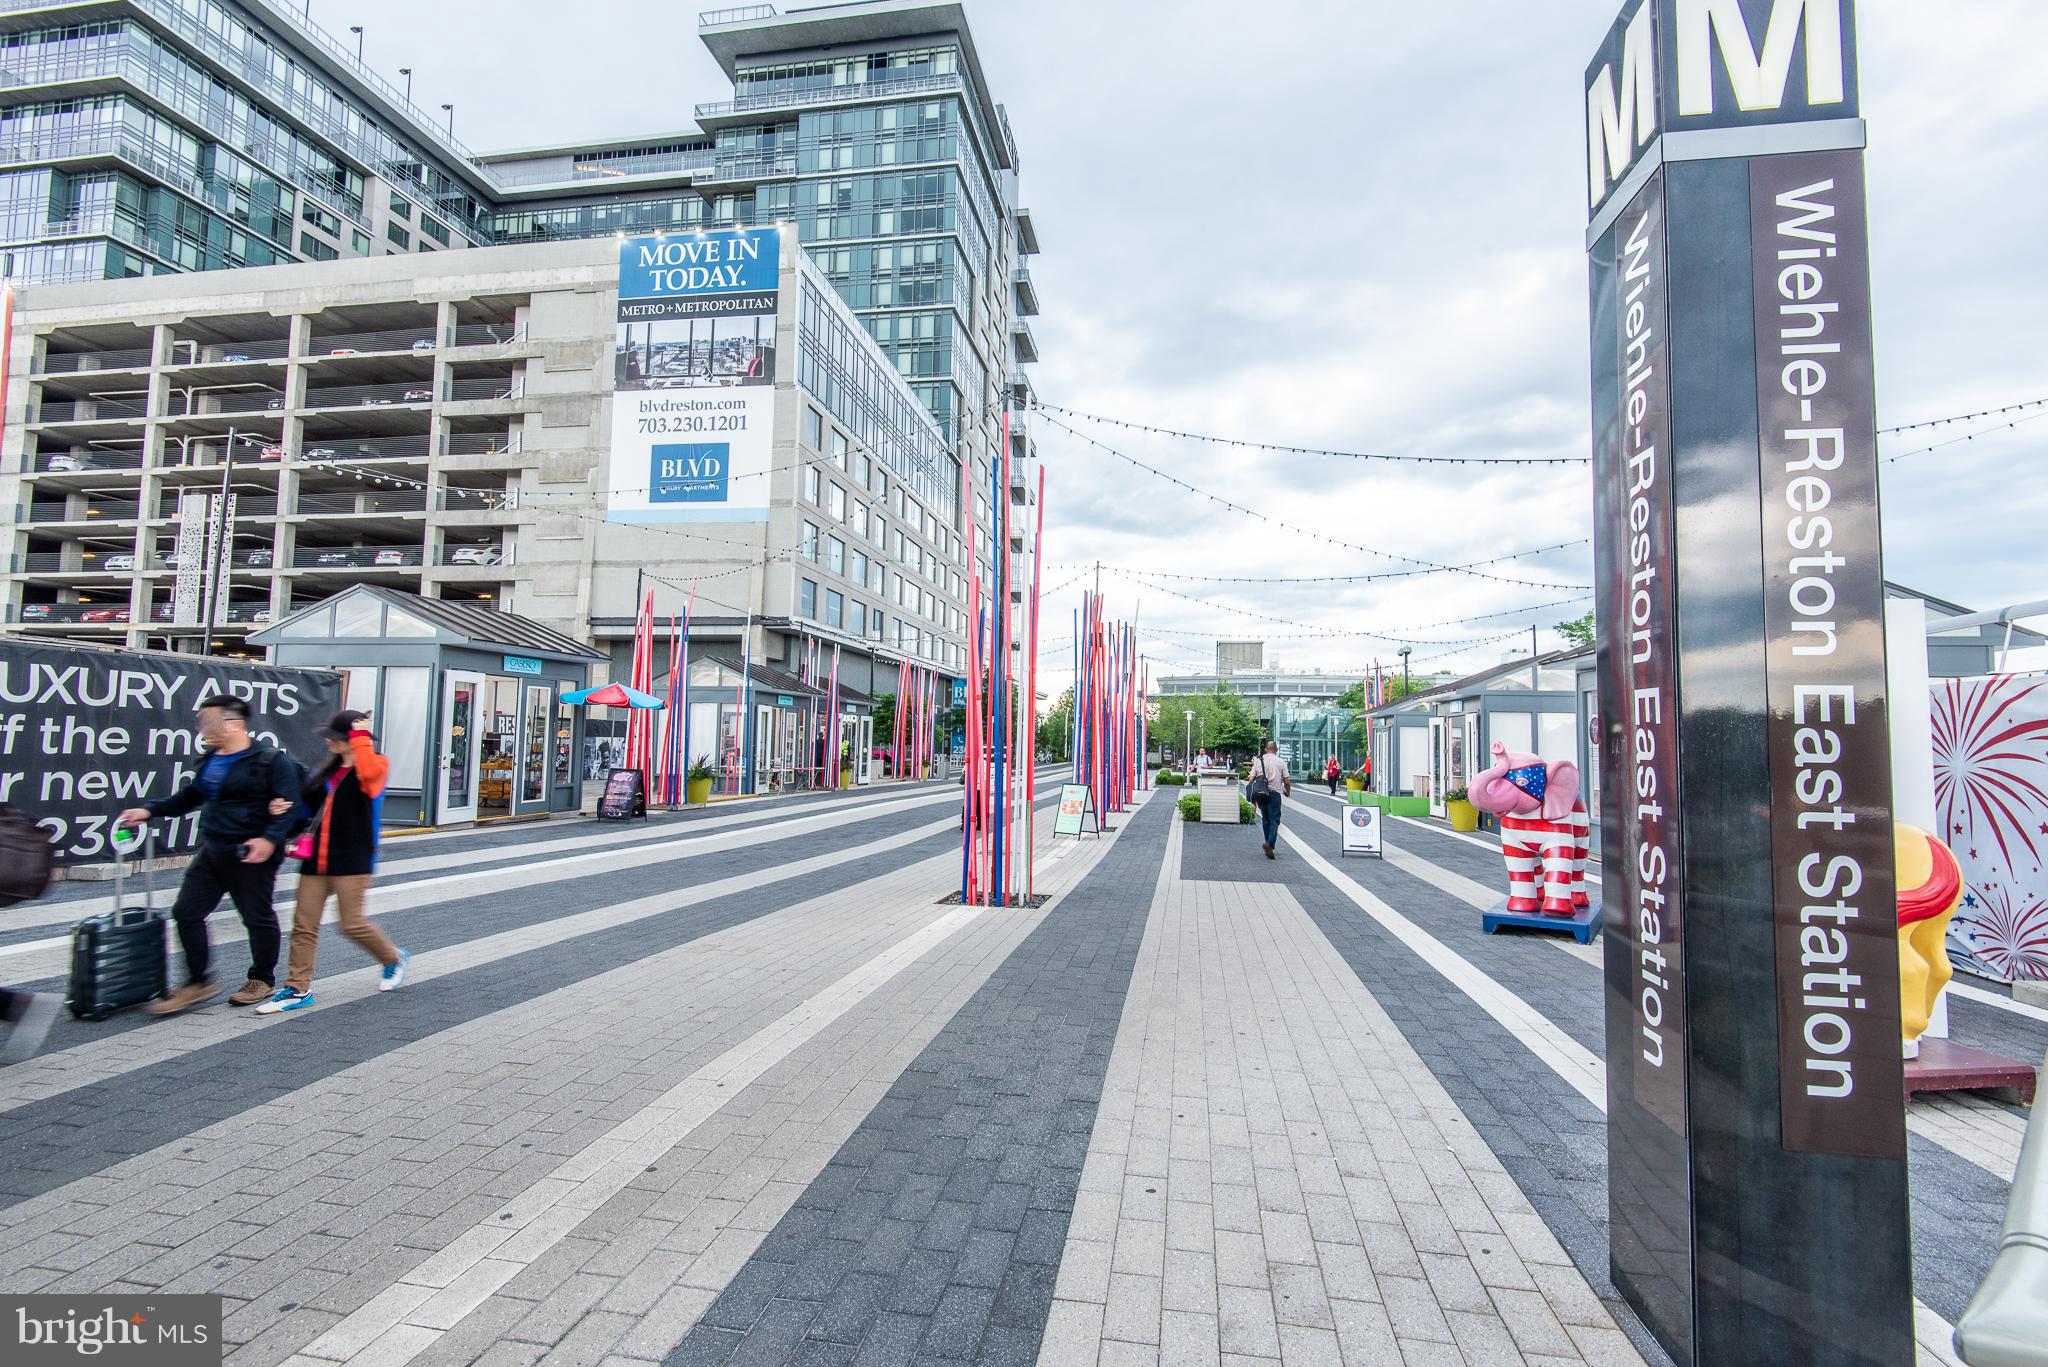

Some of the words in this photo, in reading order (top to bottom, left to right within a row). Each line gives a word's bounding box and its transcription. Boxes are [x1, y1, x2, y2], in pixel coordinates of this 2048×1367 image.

[1676, 0, 1843, 116] M
[1588, 0, 1655, 208] M
[638, 240, 720, 267] MOVE
[727, 237, 760, 261] IN
[650, 264, 747, 291] TODAY.
[621, 303, 665, 316] METRO
[675, 297, 775, 313] METROPOLITAN
[638, 415, 748, 433] 703.230.1201
[639, 400, 746, 413] blvdreston.com
[1624, 210, 1656, 664] Wiehle-Reston
[1776, 178, 1846, 657] Wiehle-Reston
[660, 449, 721, 478] BLVD
[40, 715, 130, 755] the
[1634, 687, 1664, 824] East
[1793, 684, 1856, 830] East
[40, 771, 156, 801] new
[1638, 842, 1669, 1068] Station
[1797, 852, 1866, 1098] Station
